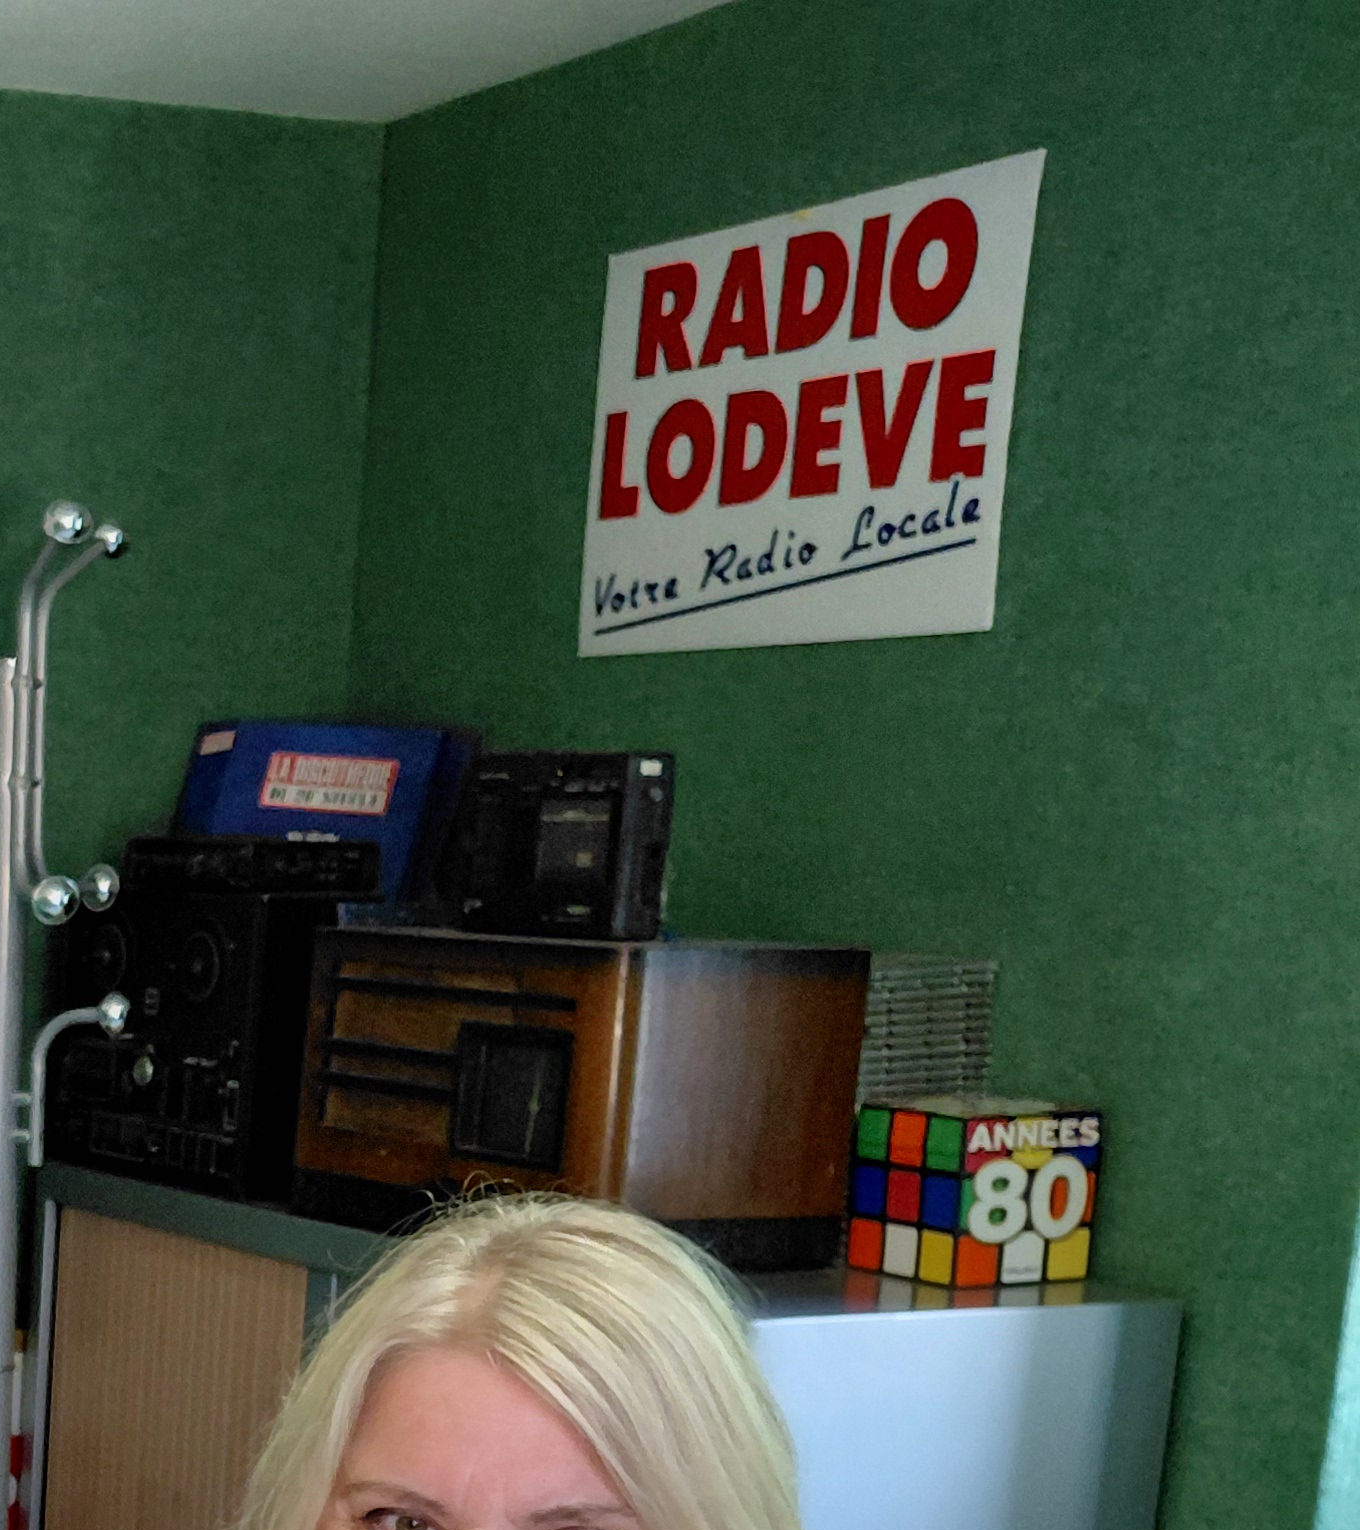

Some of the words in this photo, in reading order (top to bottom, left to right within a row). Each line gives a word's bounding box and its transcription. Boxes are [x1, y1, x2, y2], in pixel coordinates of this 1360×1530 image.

[634, 197, 979, 380] RADIO
[598, 348, 996, 520] LODEVE
[594, 572, 679, 616] Votre
[699, 529, 817, 590] Radio
[841, 480, 982, 563] Locale
[966, 1155, 1088, 1244] 80
[967, 1116, 1101, 1153] ANNEES
